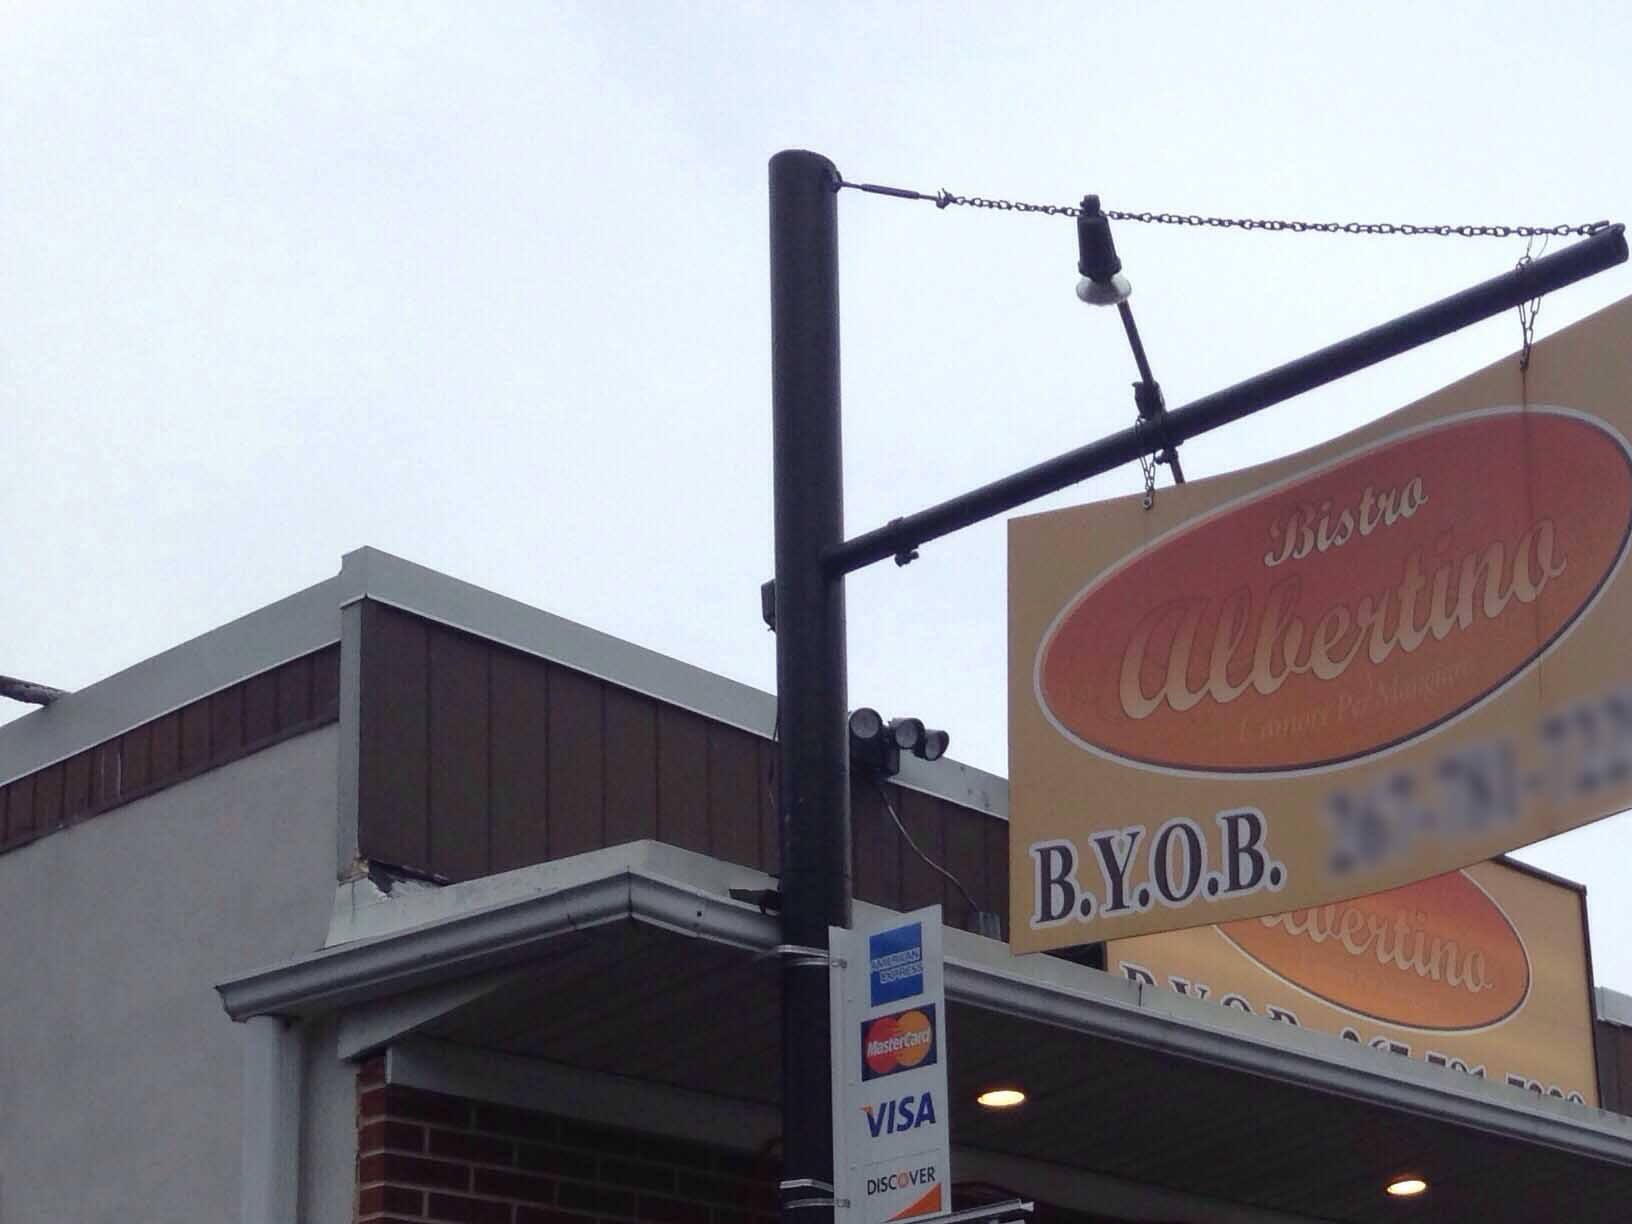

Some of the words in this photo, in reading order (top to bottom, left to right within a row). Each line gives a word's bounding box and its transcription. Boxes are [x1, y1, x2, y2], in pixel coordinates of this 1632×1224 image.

[1262, 474, 1430, 568] Bistro
[1117, 517, 1569, 720] Albertino
[1034, 812, 1283, 925] B.Y.O.B.
[1259, 903, 1495, 994] ertino
[866, 1026, 932, 1058] MasterCard
[861, 1091, 937, 1138] VISA
[866, 1166, 936, 1196] DISCOVER
